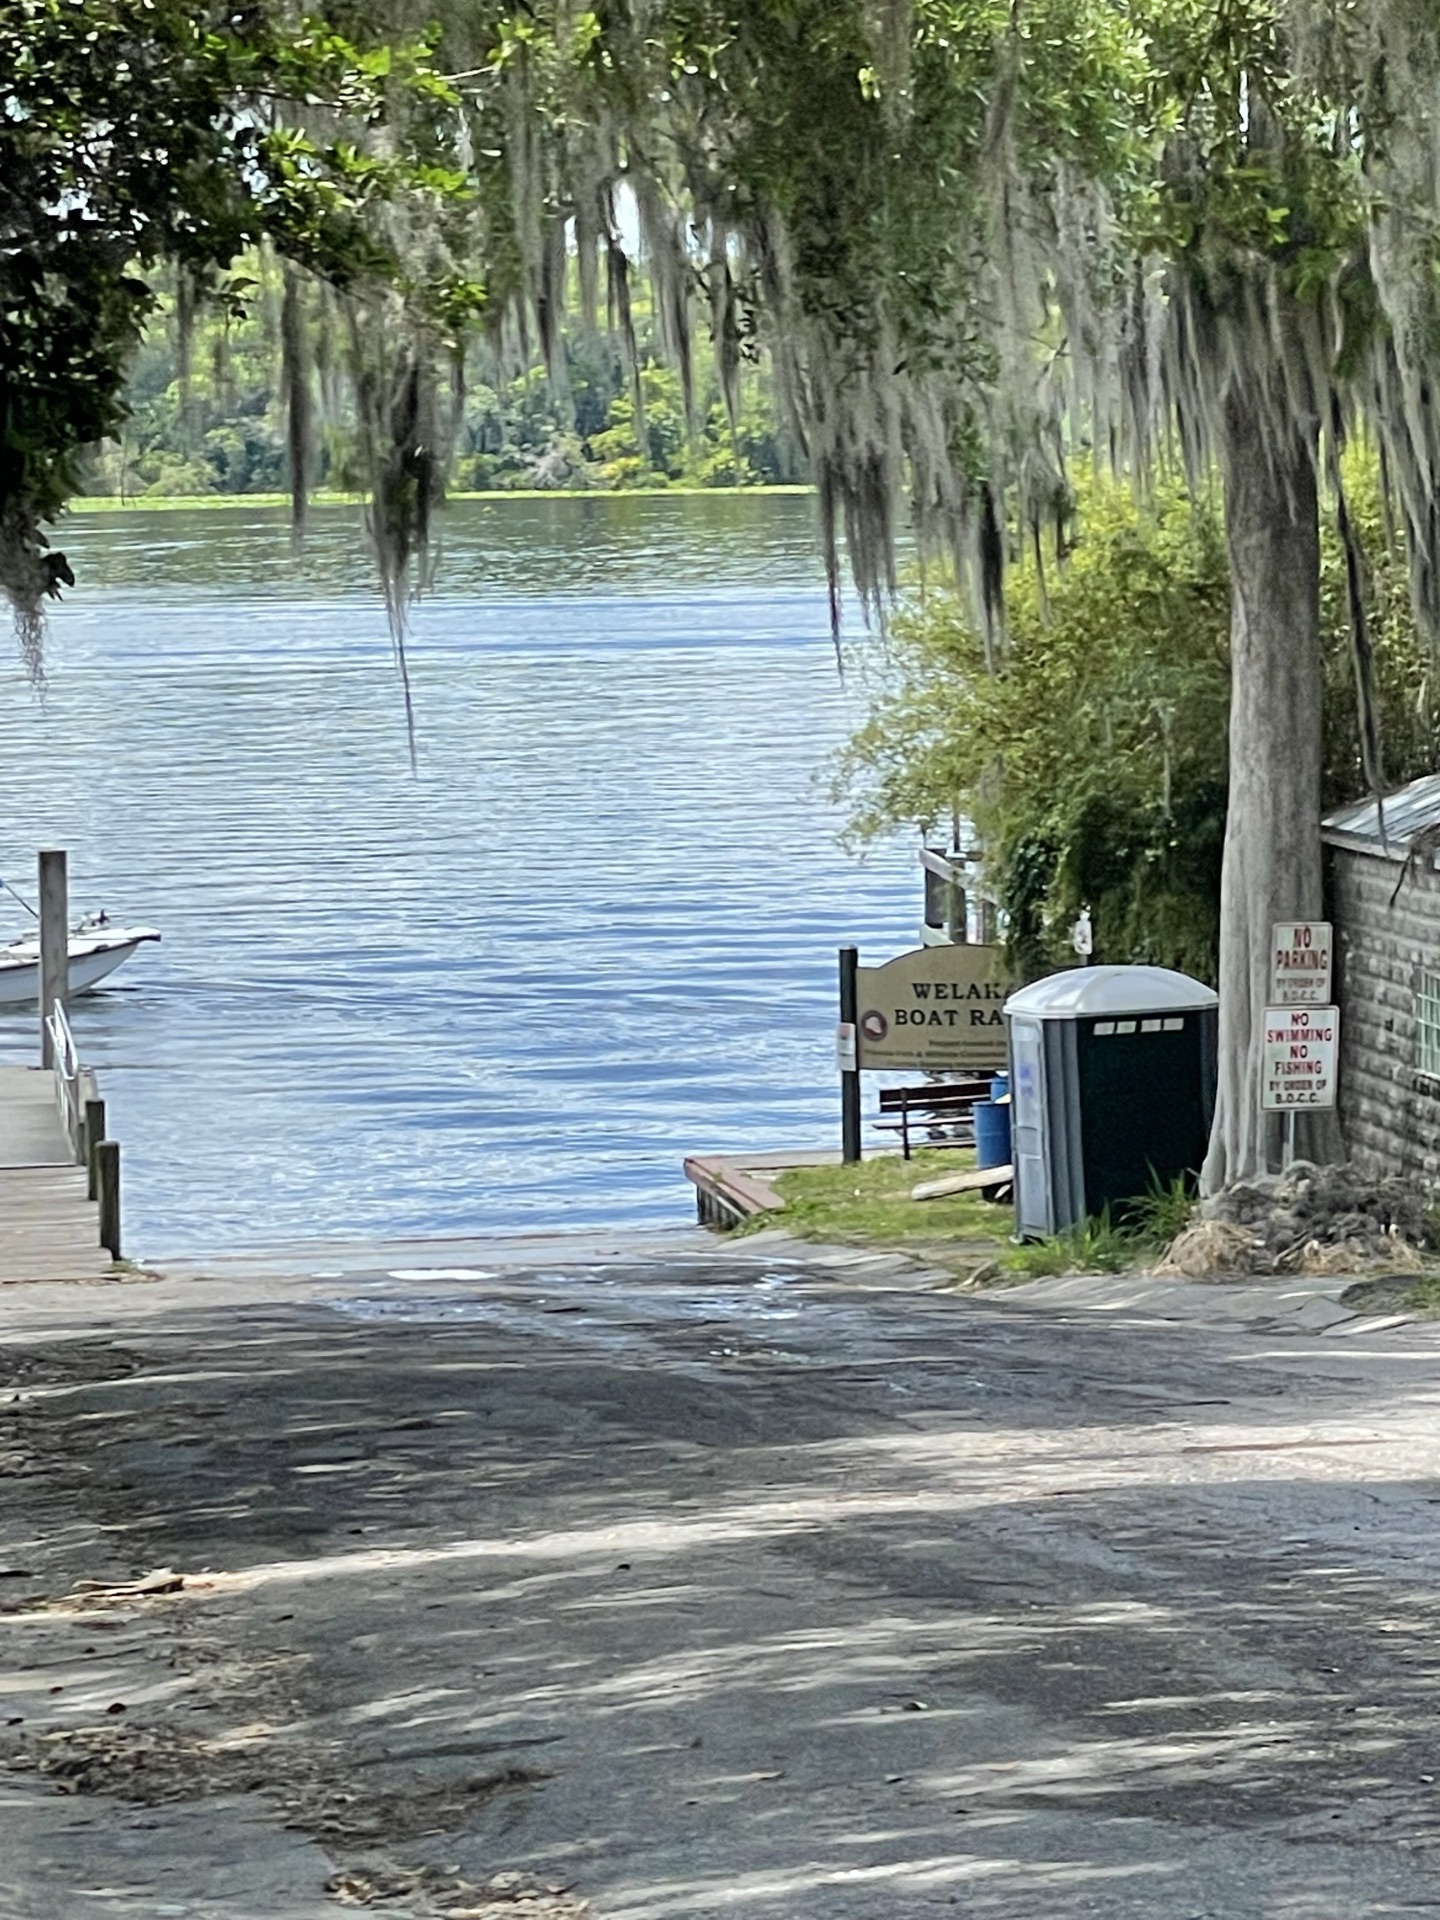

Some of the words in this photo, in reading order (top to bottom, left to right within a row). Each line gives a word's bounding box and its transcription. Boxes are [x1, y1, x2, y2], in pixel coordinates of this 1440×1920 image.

[1293, 926, 1312, 948] NO
[1276, 950, 1328, 970] PARKING
[894, 1009, 959, 1026] BOAT
[970, 1009, 1004, 1026] RA
[1291, 1012, 1309, 1026] NO
[1267, 1028, 1332, 1043] SWIMMING
[1290, 1045, 1308, 1059] NO
[1274, 1061, 1323, 1076] FISHING
[1316, 1079, 1327, 1090] OF
